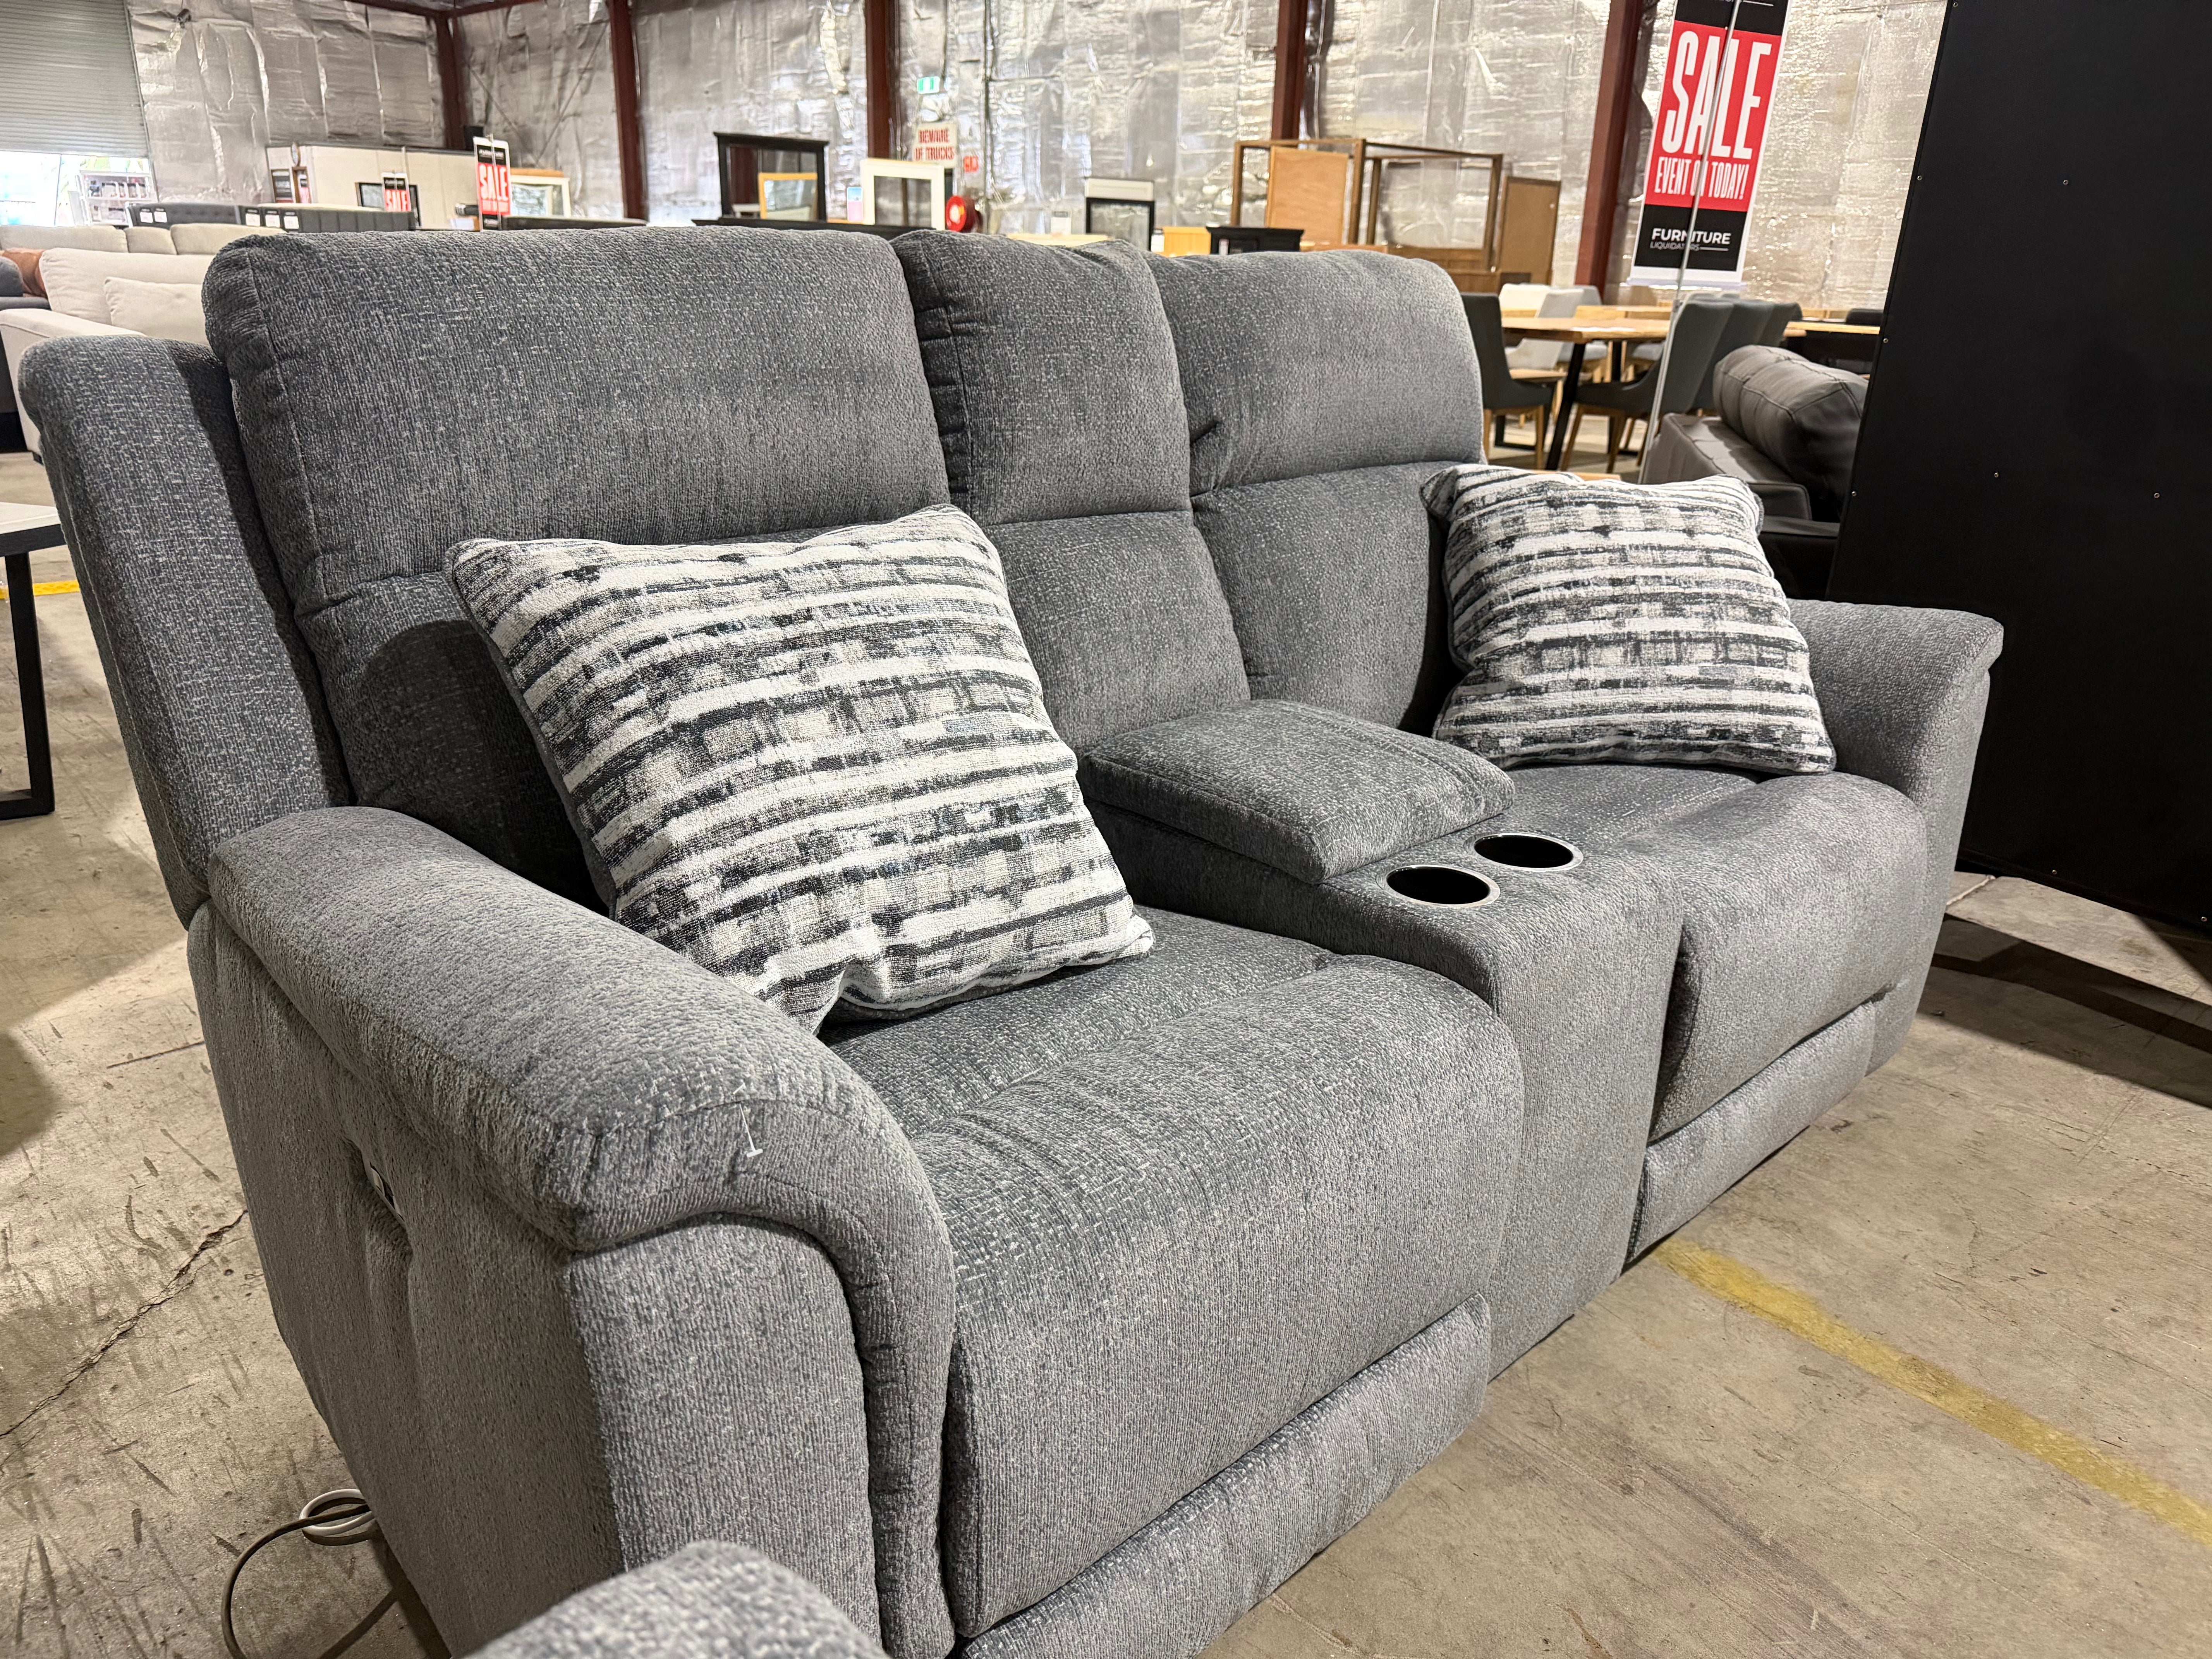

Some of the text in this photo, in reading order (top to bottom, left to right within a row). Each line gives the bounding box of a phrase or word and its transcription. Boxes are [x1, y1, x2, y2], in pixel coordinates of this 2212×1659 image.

[1662, 31, 1772, 160] SALE
[919, 129, 949, 144] BEWARE
[914, 146, 954, 161] OF TRUCKS
[479, 164, 508, 201] SALE
[1654, 156, 1692, 196] EVENT
[1708, 161, 1750, 200] TODAY!
[1651, 227, 1732, 245] FURNITURE
